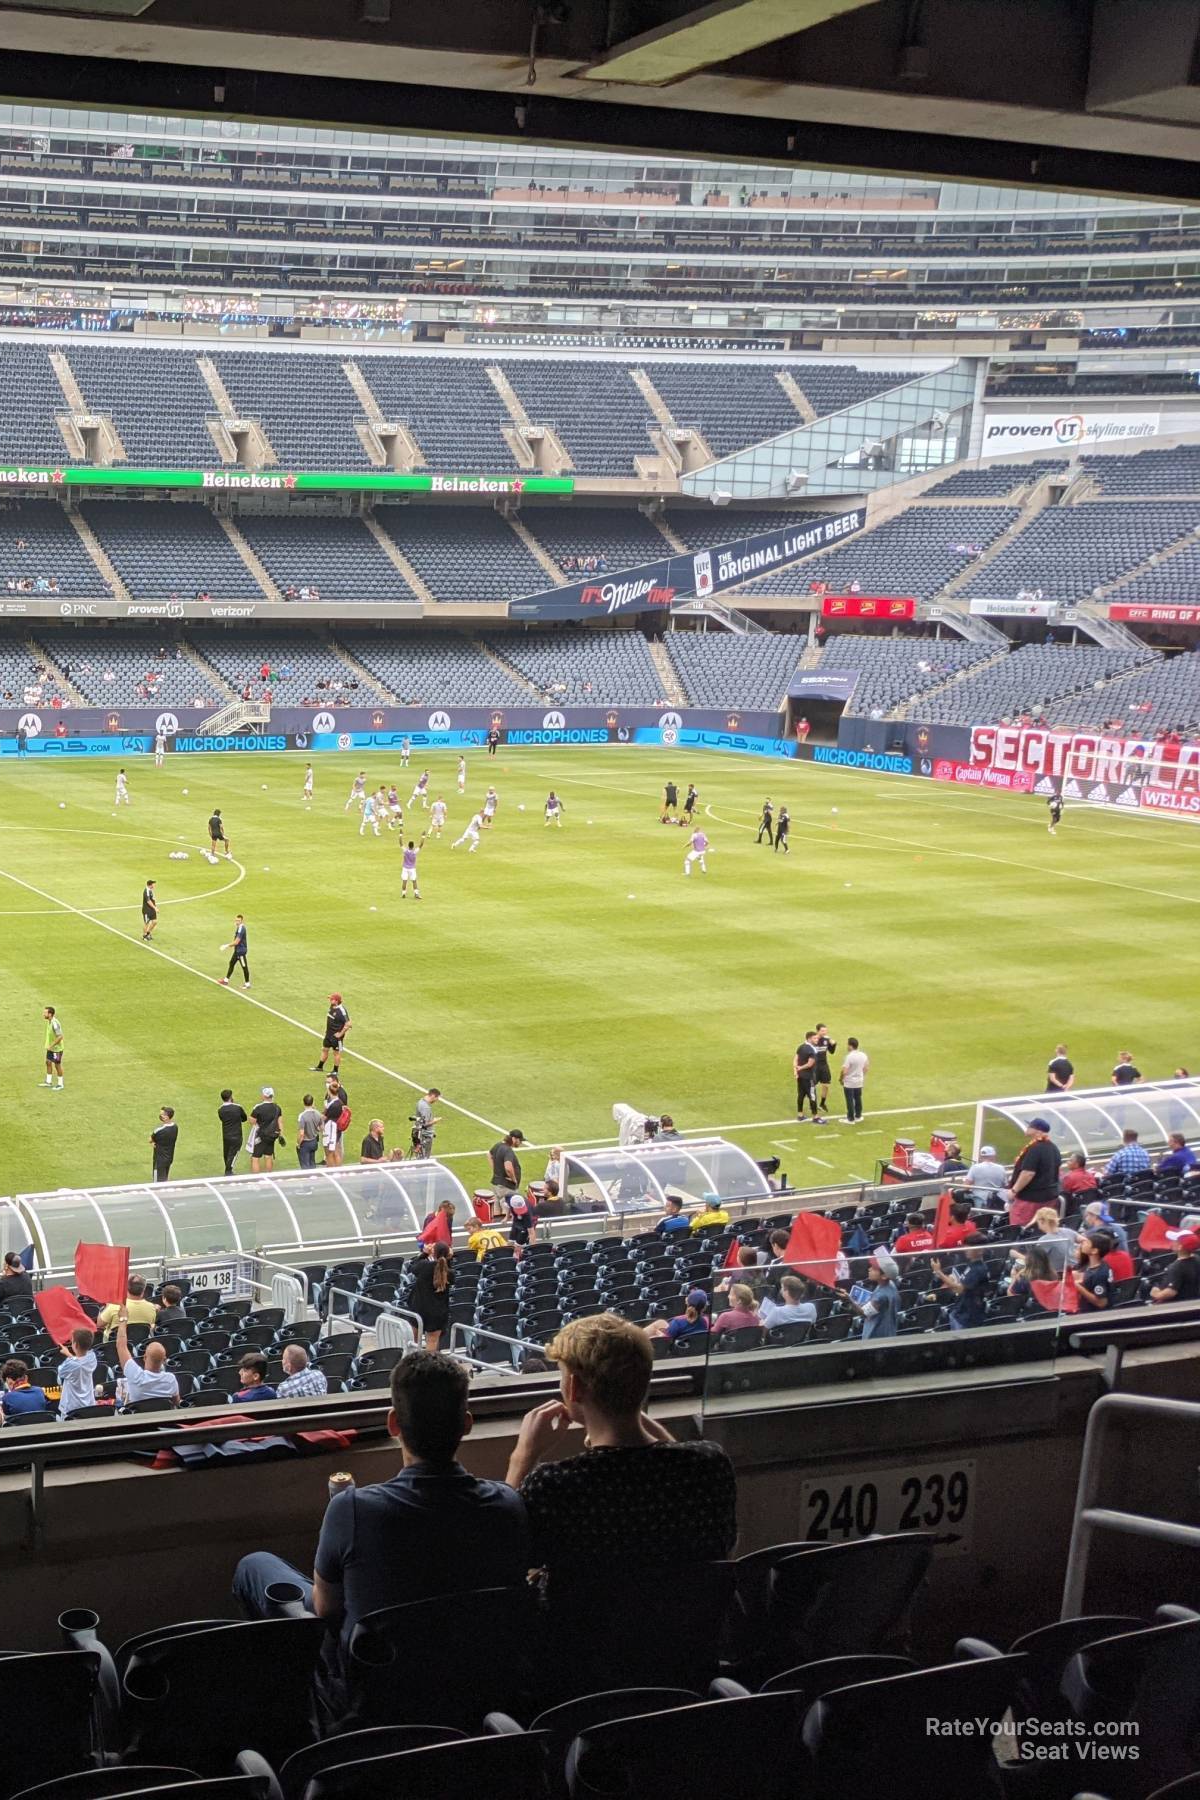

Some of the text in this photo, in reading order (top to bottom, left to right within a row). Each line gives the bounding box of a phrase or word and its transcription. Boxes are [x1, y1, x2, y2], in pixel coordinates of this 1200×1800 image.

[987, 422, 1156, 439] proven IT skyline suite
[202, 471, 281, 488] Heineken
[431, 477, 508, 493] Heineken
[718, 512, 859, 581] ORIGINAL LIGHT BEER
[718, 551, 732, 563] THE
[601, 578, 658, 614] Miller
[647, 587, 675, 604] TIME
[74, 604, 97, 615] PNC
[127, 605, 166, 617] proven
[210, 606, 250, 617] verizon
[986, 604, 1026, 613] Heineken
[1152, 609, 1176, 619] RING
[1179, 610, 1194, 620] OF
[175, 736, 287, 752] MICROPHONES
[507, 730, 608, 744] MICROPHONES
[814, 746, 912, 774] MICROPHONES
[970, 726, 1124, 783] SECTOR
[955, 764, 982, 781] Captain
[982, 767, 1010, 786] Morgan
[480, 1235, 502, 1251] 20
[191, 1271, 231, 1289] 140 138
[806, 1471, 968, 1541] 240 239
